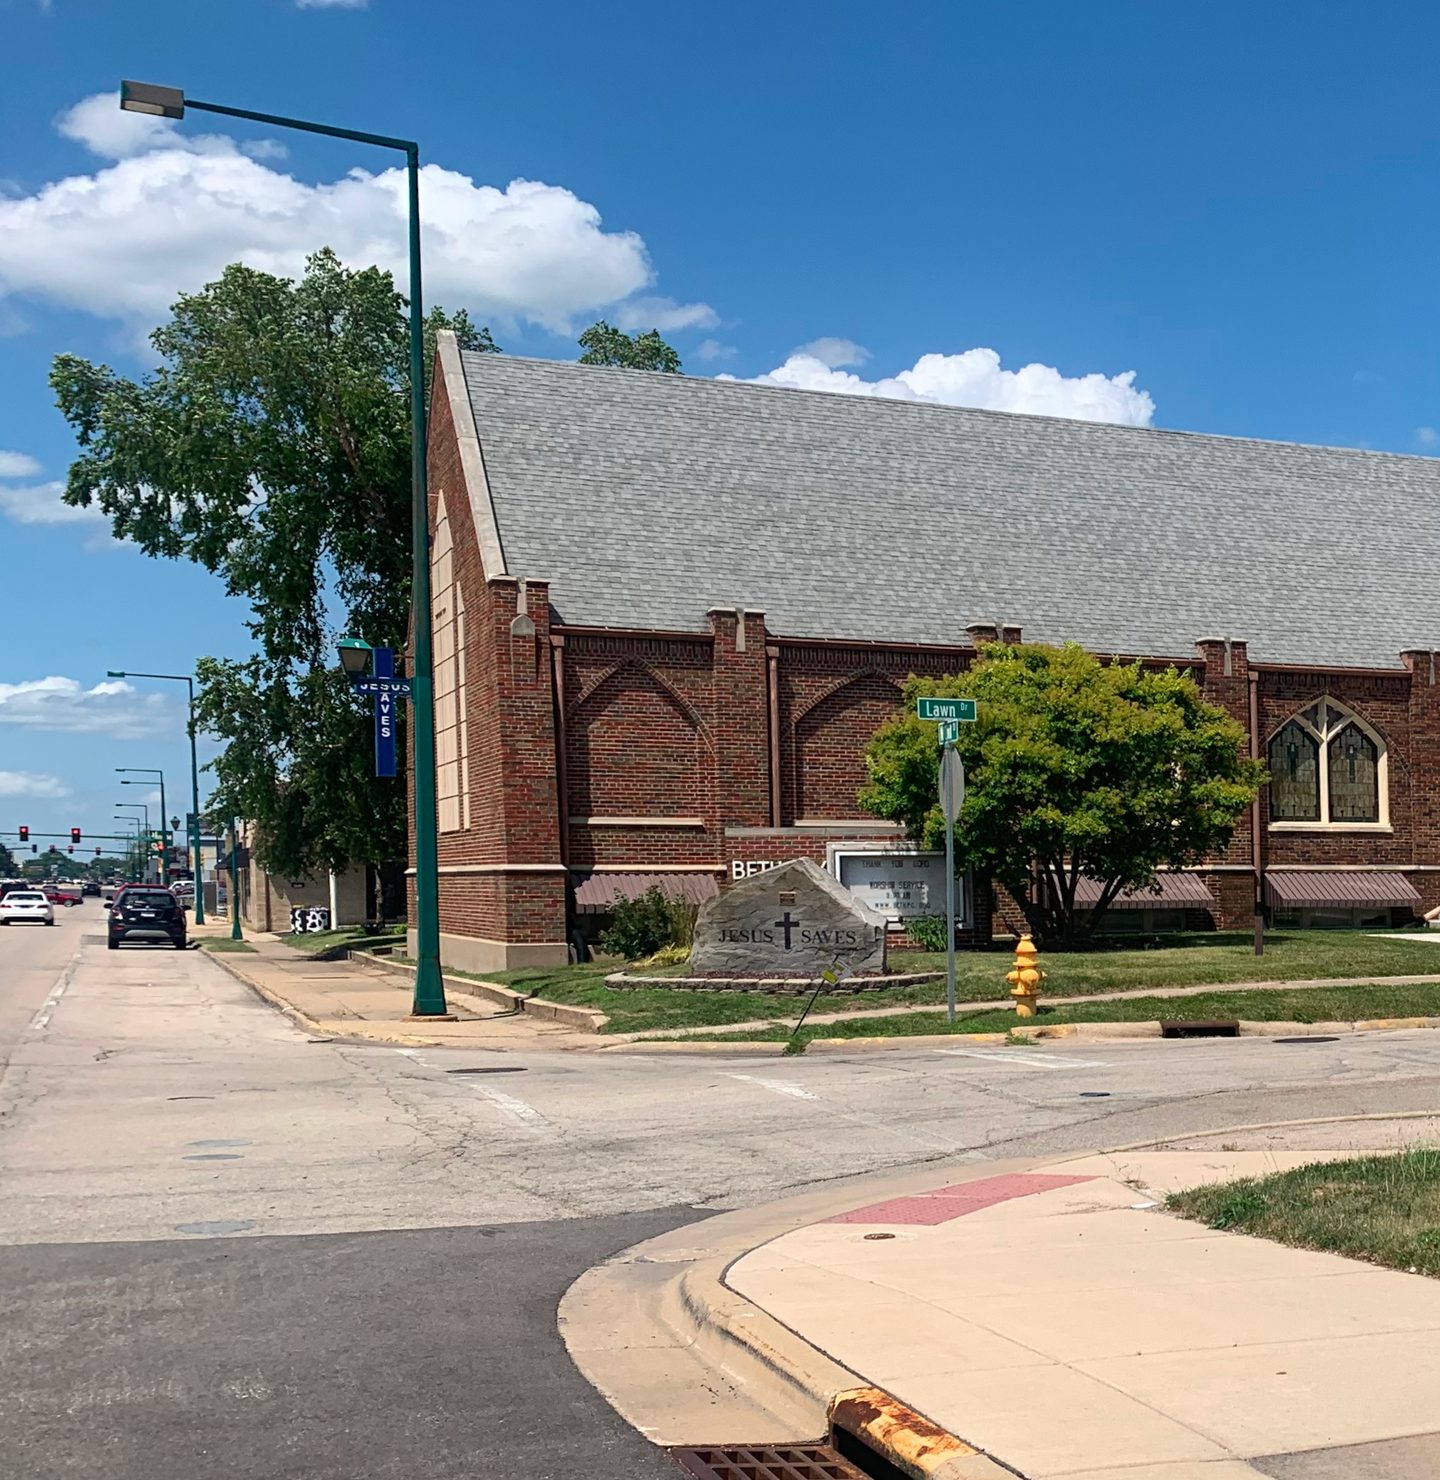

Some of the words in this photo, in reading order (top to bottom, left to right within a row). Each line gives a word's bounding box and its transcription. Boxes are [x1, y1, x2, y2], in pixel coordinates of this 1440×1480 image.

[360, 683, 410, 691] JESUS
[926, 701, 956, 717] Lawn
[960, 702, 968, 711] Dr
[718, 929, 773, 943] JESUS
[801, 929, 857, 944] SAVES
